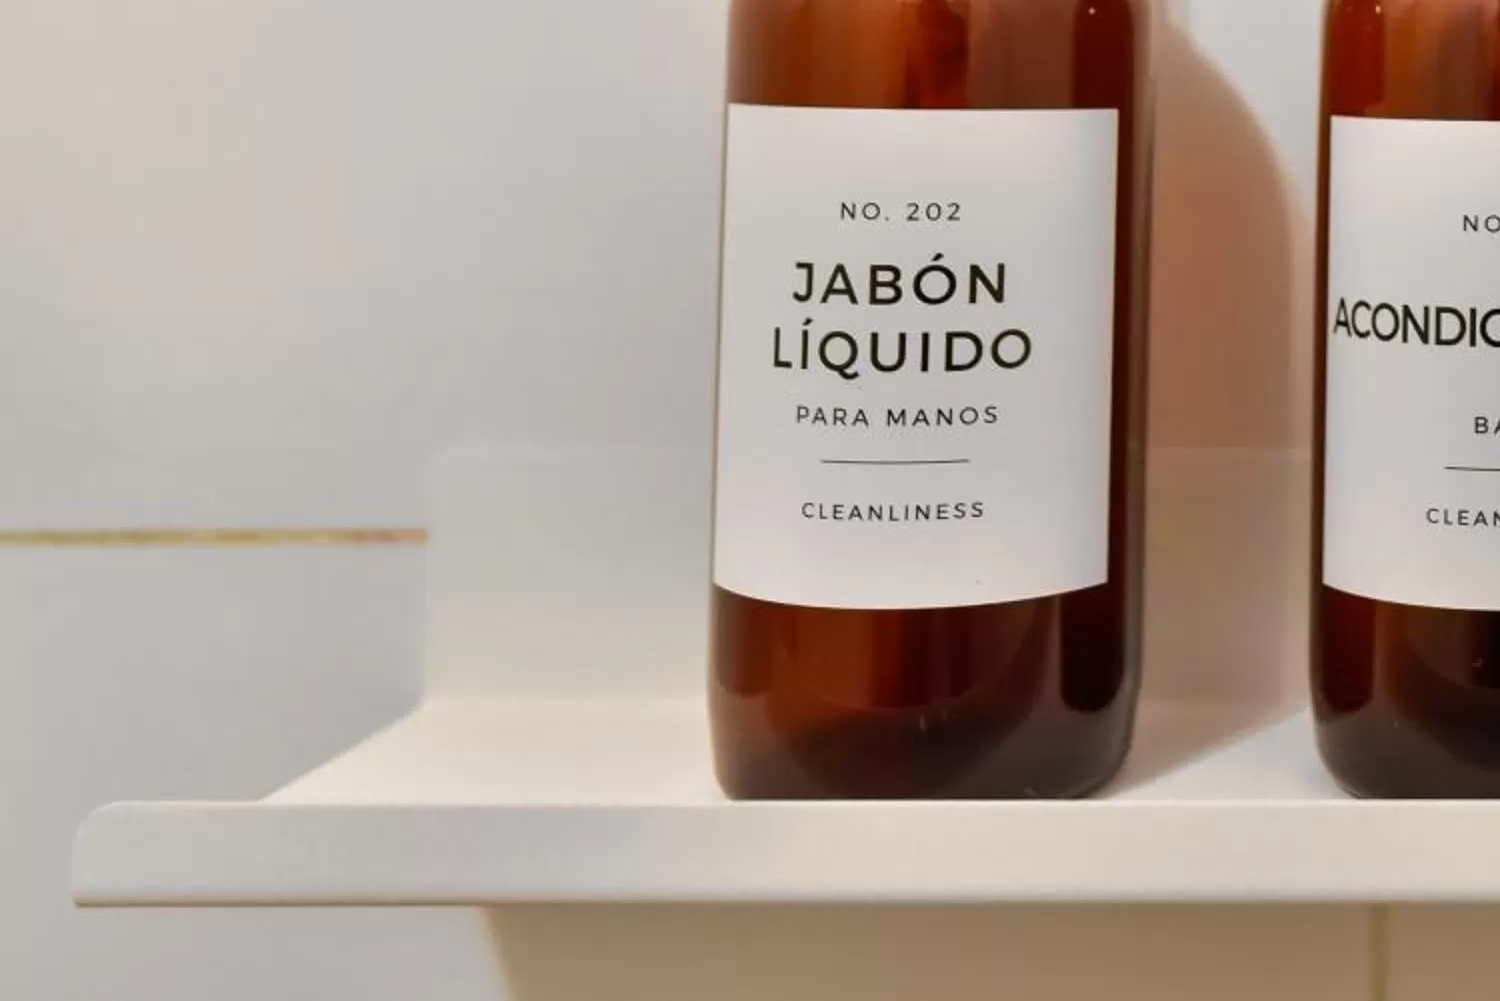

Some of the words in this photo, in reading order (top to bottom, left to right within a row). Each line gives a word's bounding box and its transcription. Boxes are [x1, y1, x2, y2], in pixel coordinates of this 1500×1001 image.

[839, 201, 890, 222] NO.
[905, 202, 962, 222] 202
[791, 252, 1007, 306] JABÓN
[771, 316, 1033, 382] LÍQUIDO
[795, 404, 870, 428] PARA
[885, 405, 999, 429] MANOS
[800, 501, 985, 522] CLEANLINESS
